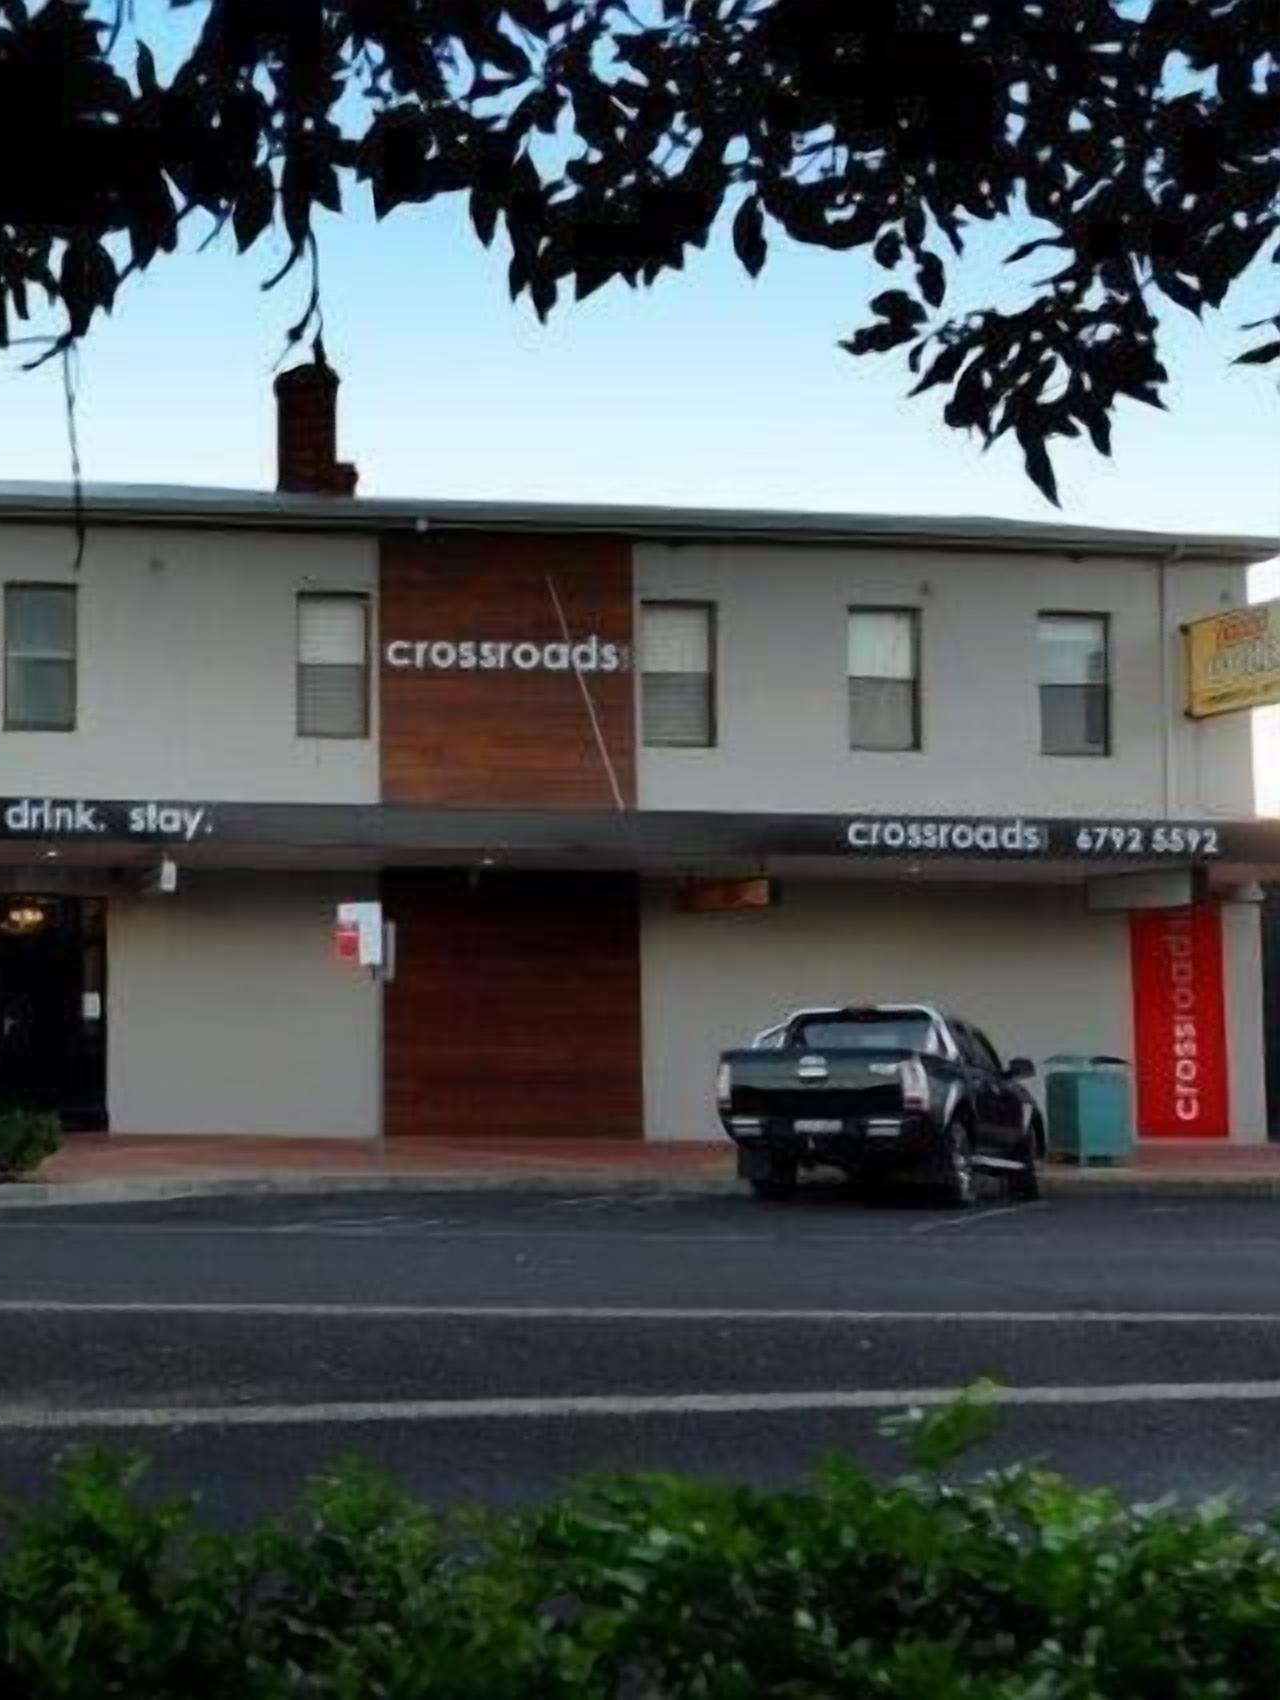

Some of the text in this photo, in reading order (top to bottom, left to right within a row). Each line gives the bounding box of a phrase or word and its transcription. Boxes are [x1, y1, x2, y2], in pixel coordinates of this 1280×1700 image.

[387, 635, 619, 670] crossroads
[4, 800, 106, 832] drink.
[129, 804, 213, 841] stay.
[847, 818, 1041, 849] crossroads
[1076, 827, 1144, 853] 6792
